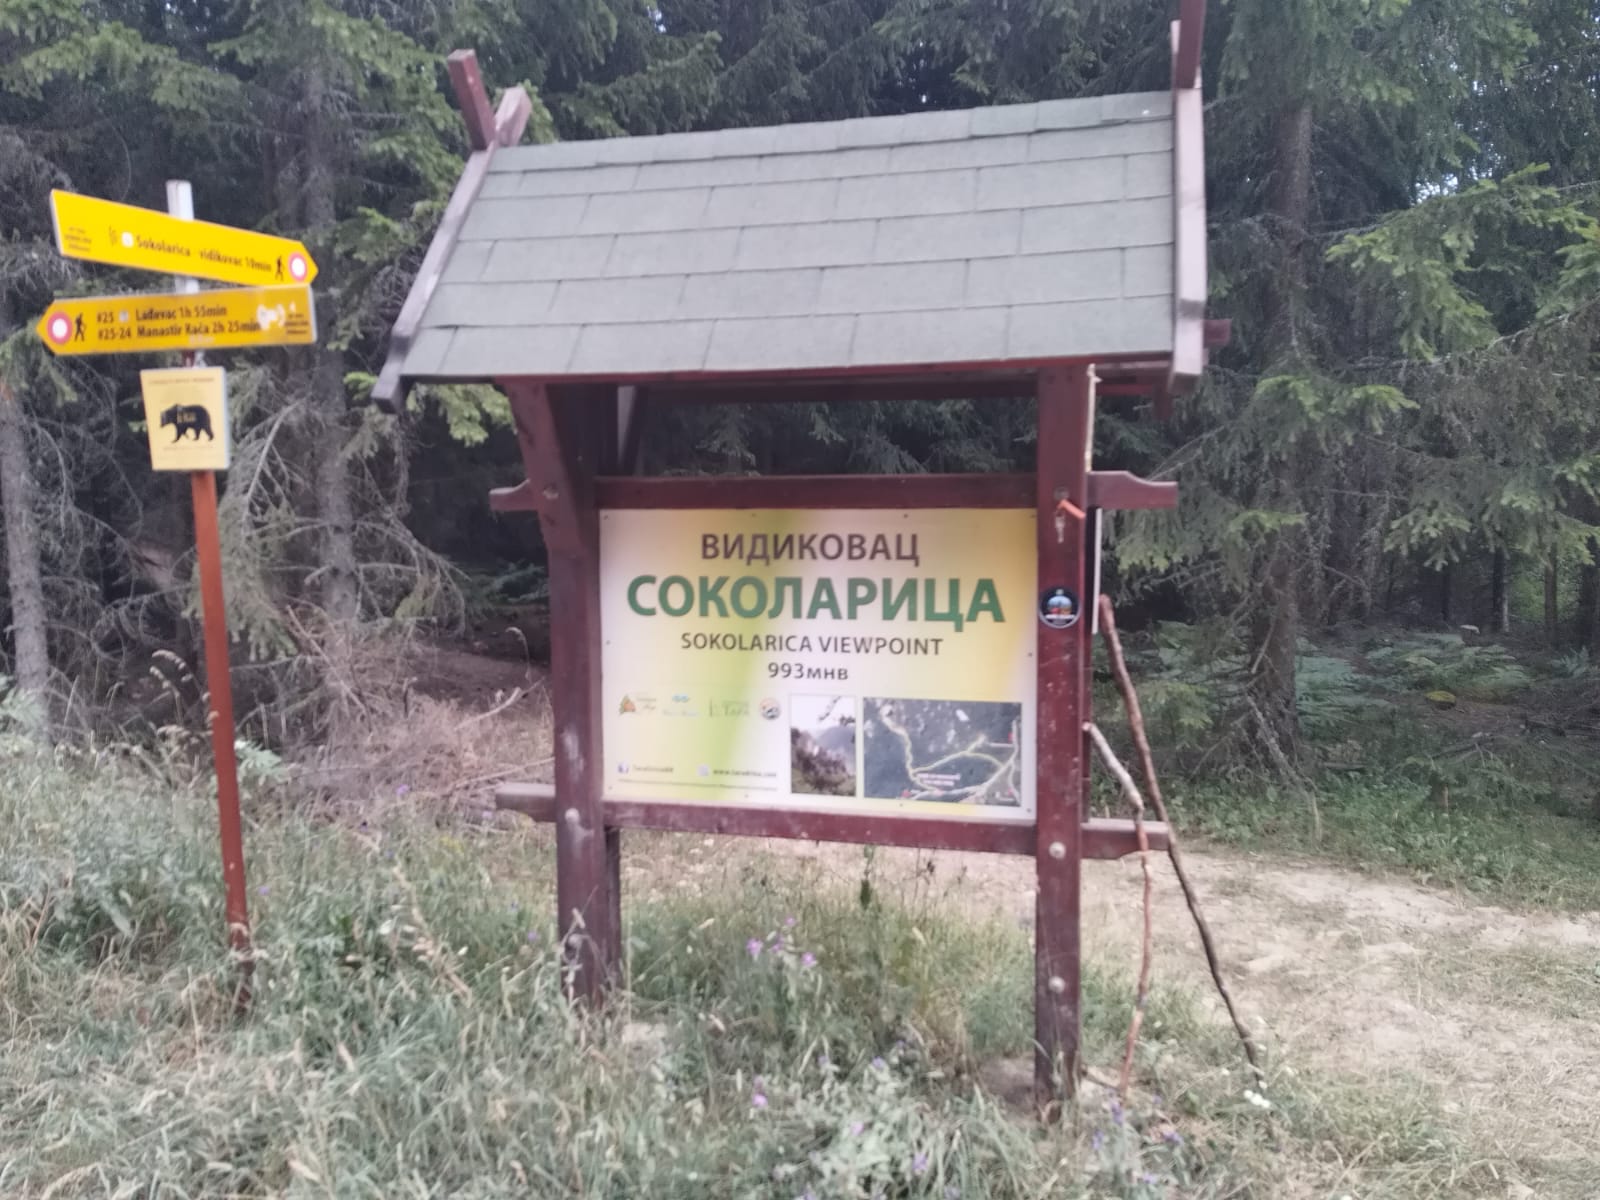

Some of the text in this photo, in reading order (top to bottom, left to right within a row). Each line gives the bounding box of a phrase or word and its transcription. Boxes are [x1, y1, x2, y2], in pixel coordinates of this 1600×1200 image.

[136, 235, 191, 257] Sokolarica
[200, 248, 242, 266] vidikovac
[180, 305, 192, 318] 1h
[194, 303, 227, 317] 55min
[137, 323, 181, 337] Manastir
[213, 319, 225, 333] 2h
[228, 316, 260, 333] 25min
[700, 533, 920, 567] ВИДИКОВАЦ
[627, 575, 1006, 632] СОКОЛАРИЦА
[681, 632, 944, 656] SOKOLARICA VIEWPOINT
[768, 662, 849, 681] 993мнв
